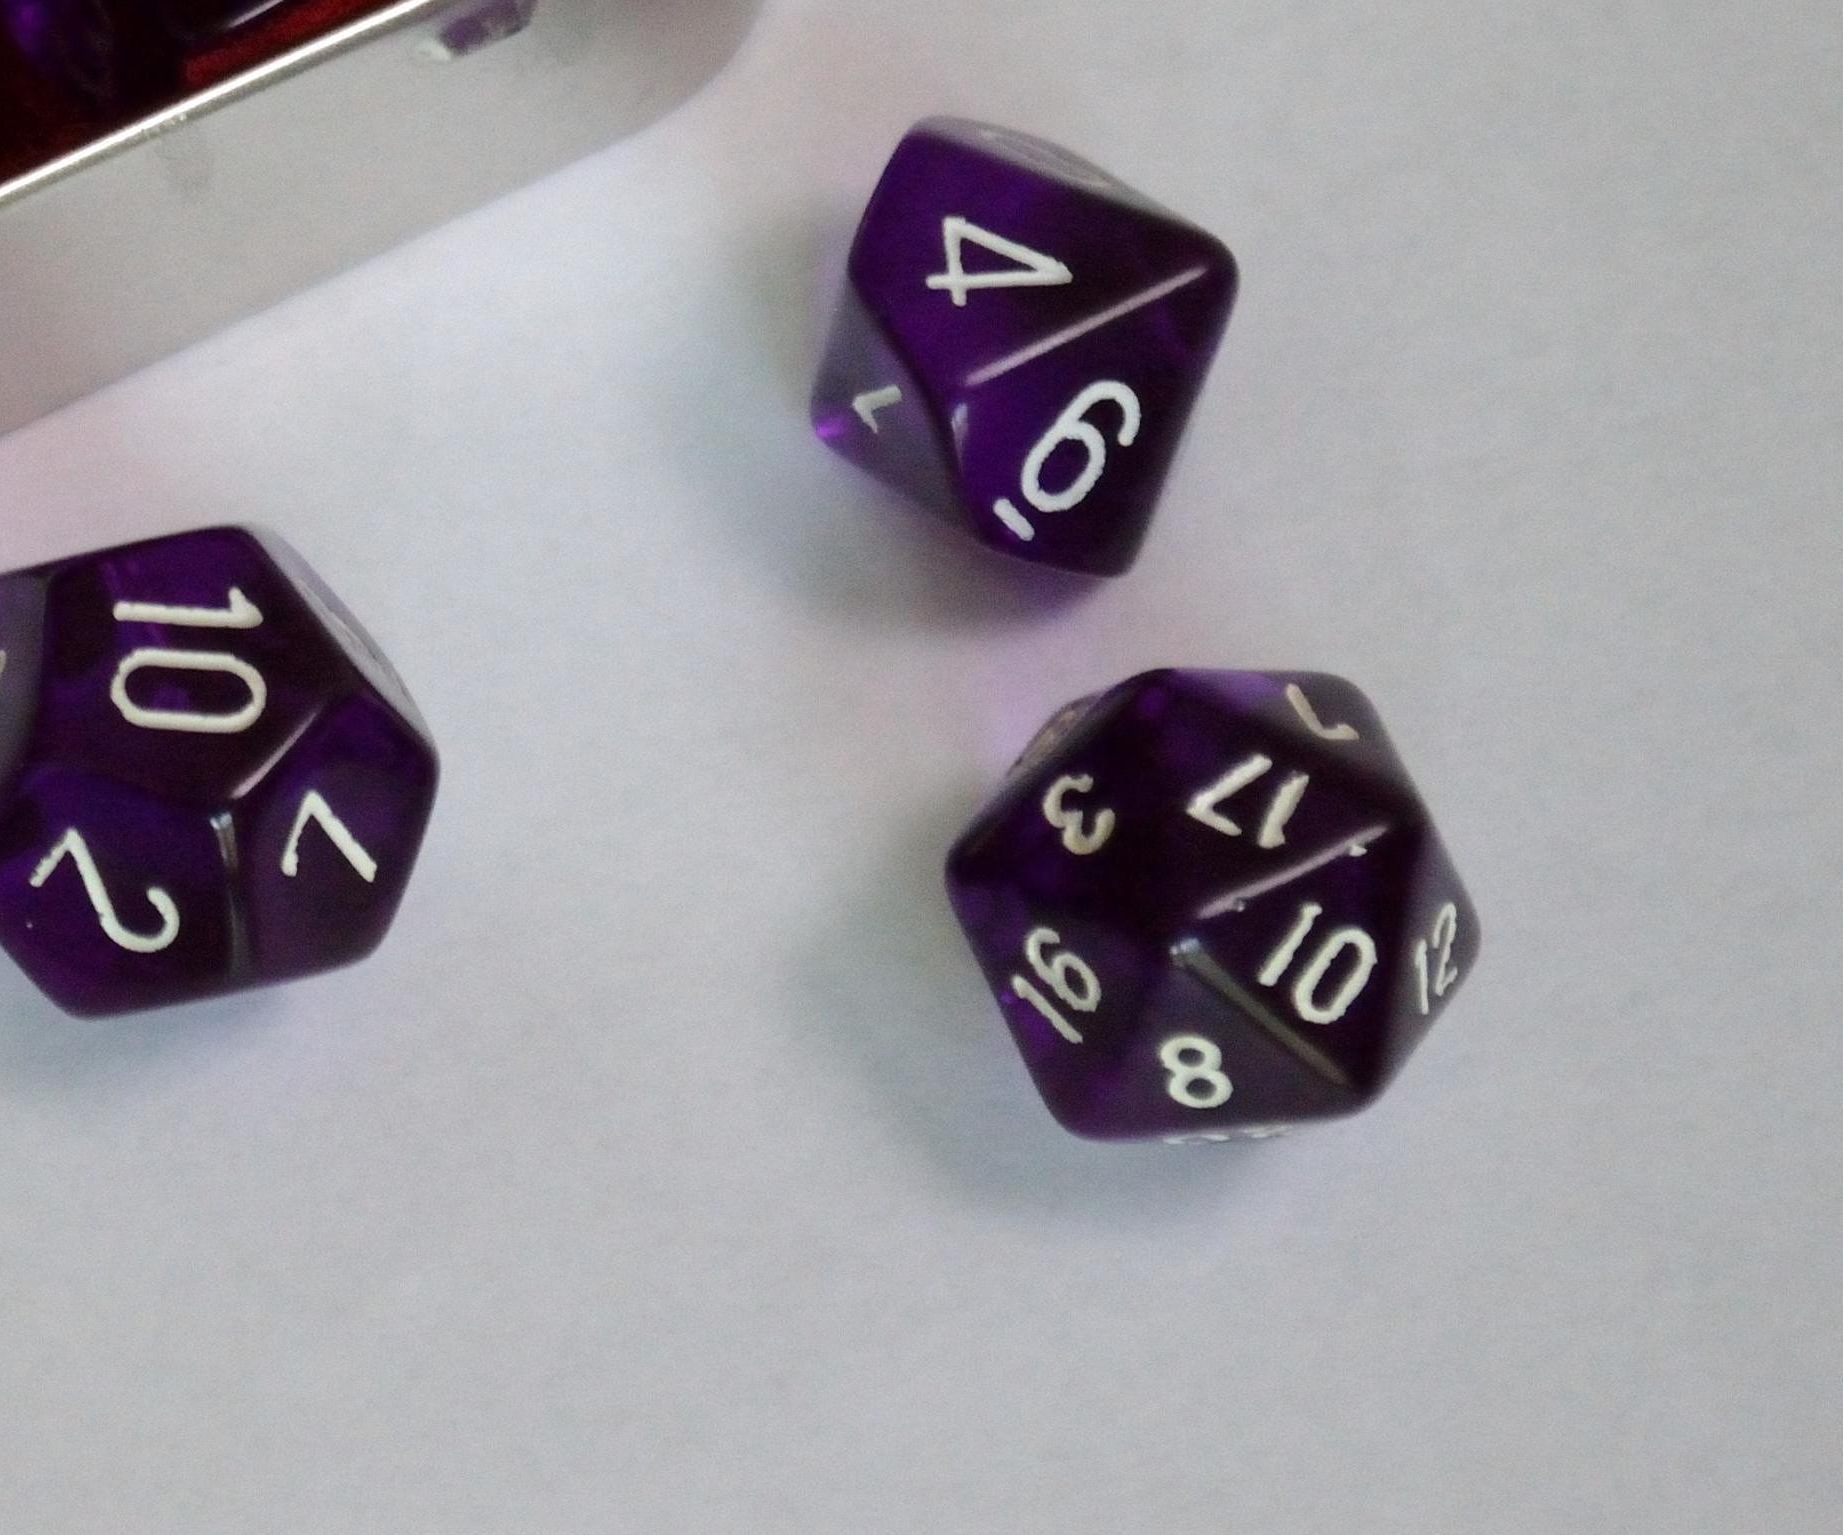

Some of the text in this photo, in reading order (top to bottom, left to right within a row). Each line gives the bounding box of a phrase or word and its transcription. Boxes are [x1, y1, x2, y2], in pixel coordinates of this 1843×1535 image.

[926, 216, 1073, 306] 4
[111, 587, 267, 734] 10
[1043, 773, 1115, 855] 3
[1186, 754, 1310, 850] 17
[29, 828, 179, 953] 2
[1012, 927, 1101, 1044] 16
[1259, 901, 1378, 1025] 10
[1414, 902, 1457, 1015] 12
[1160, 1035, 1234, 1108] 8
